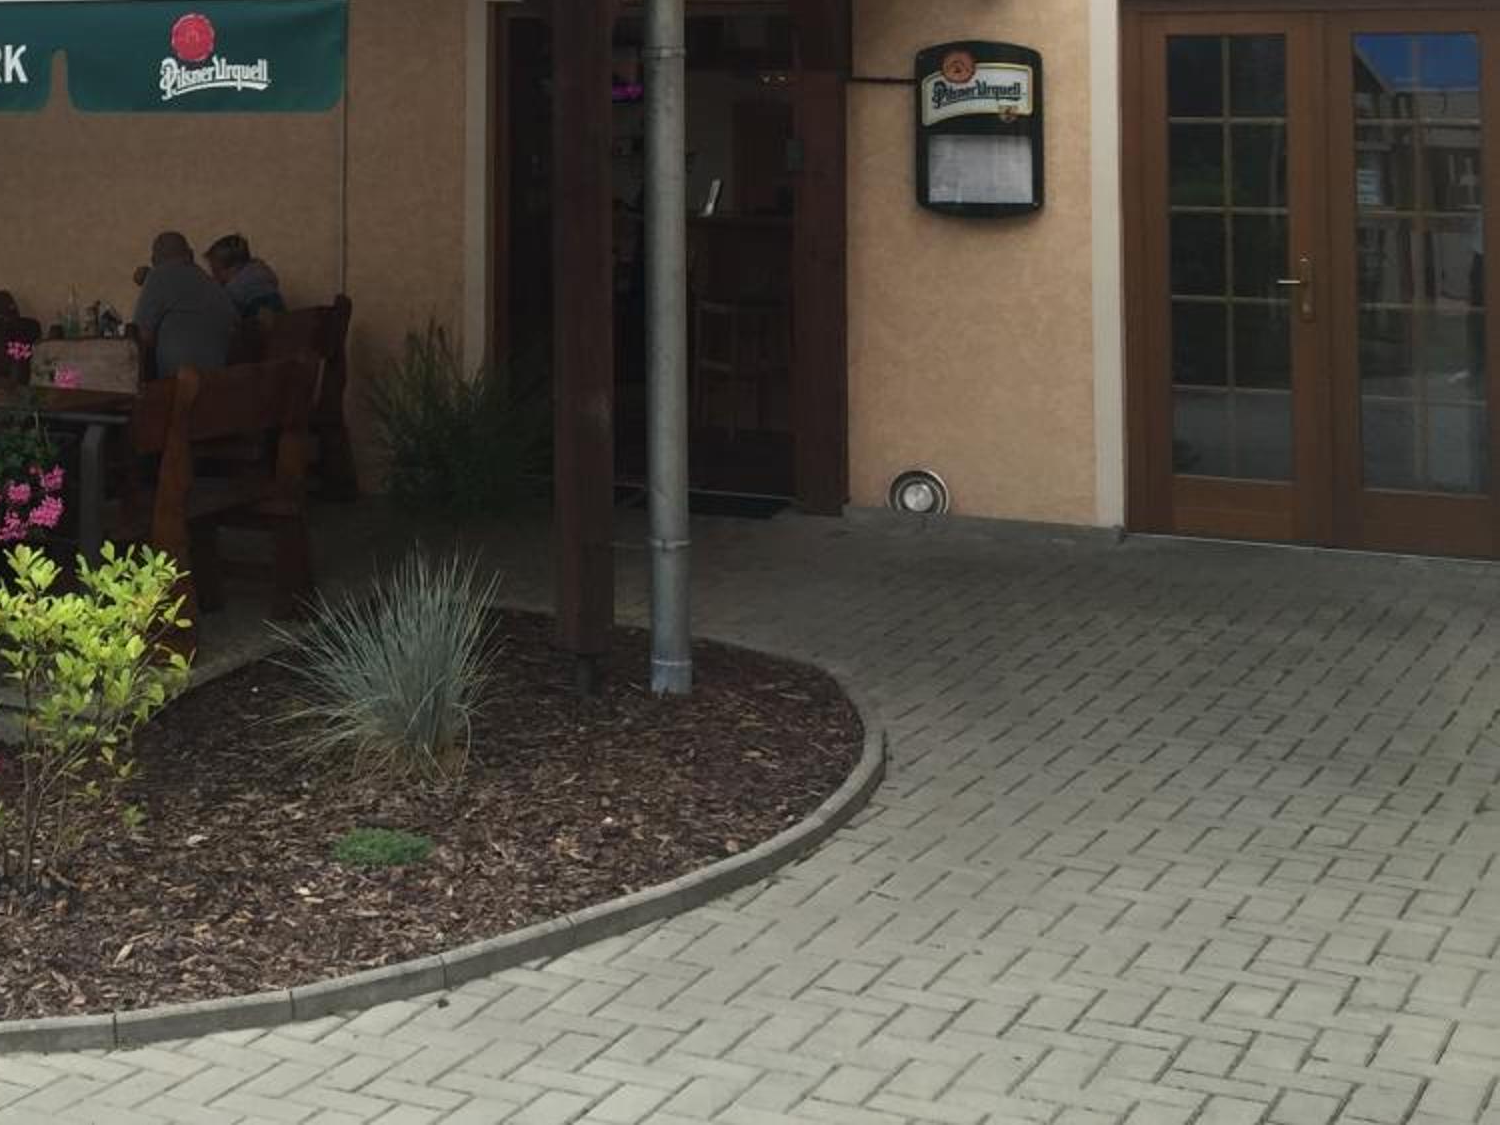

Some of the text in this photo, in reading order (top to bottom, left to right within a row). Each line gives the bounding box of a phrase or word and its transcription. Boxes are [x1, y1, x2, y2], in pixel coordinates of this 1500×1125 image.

[159, 55, 270, 100] Pilsner Urquell
[931, 79, 1021, 109] Pilsner Urquell
